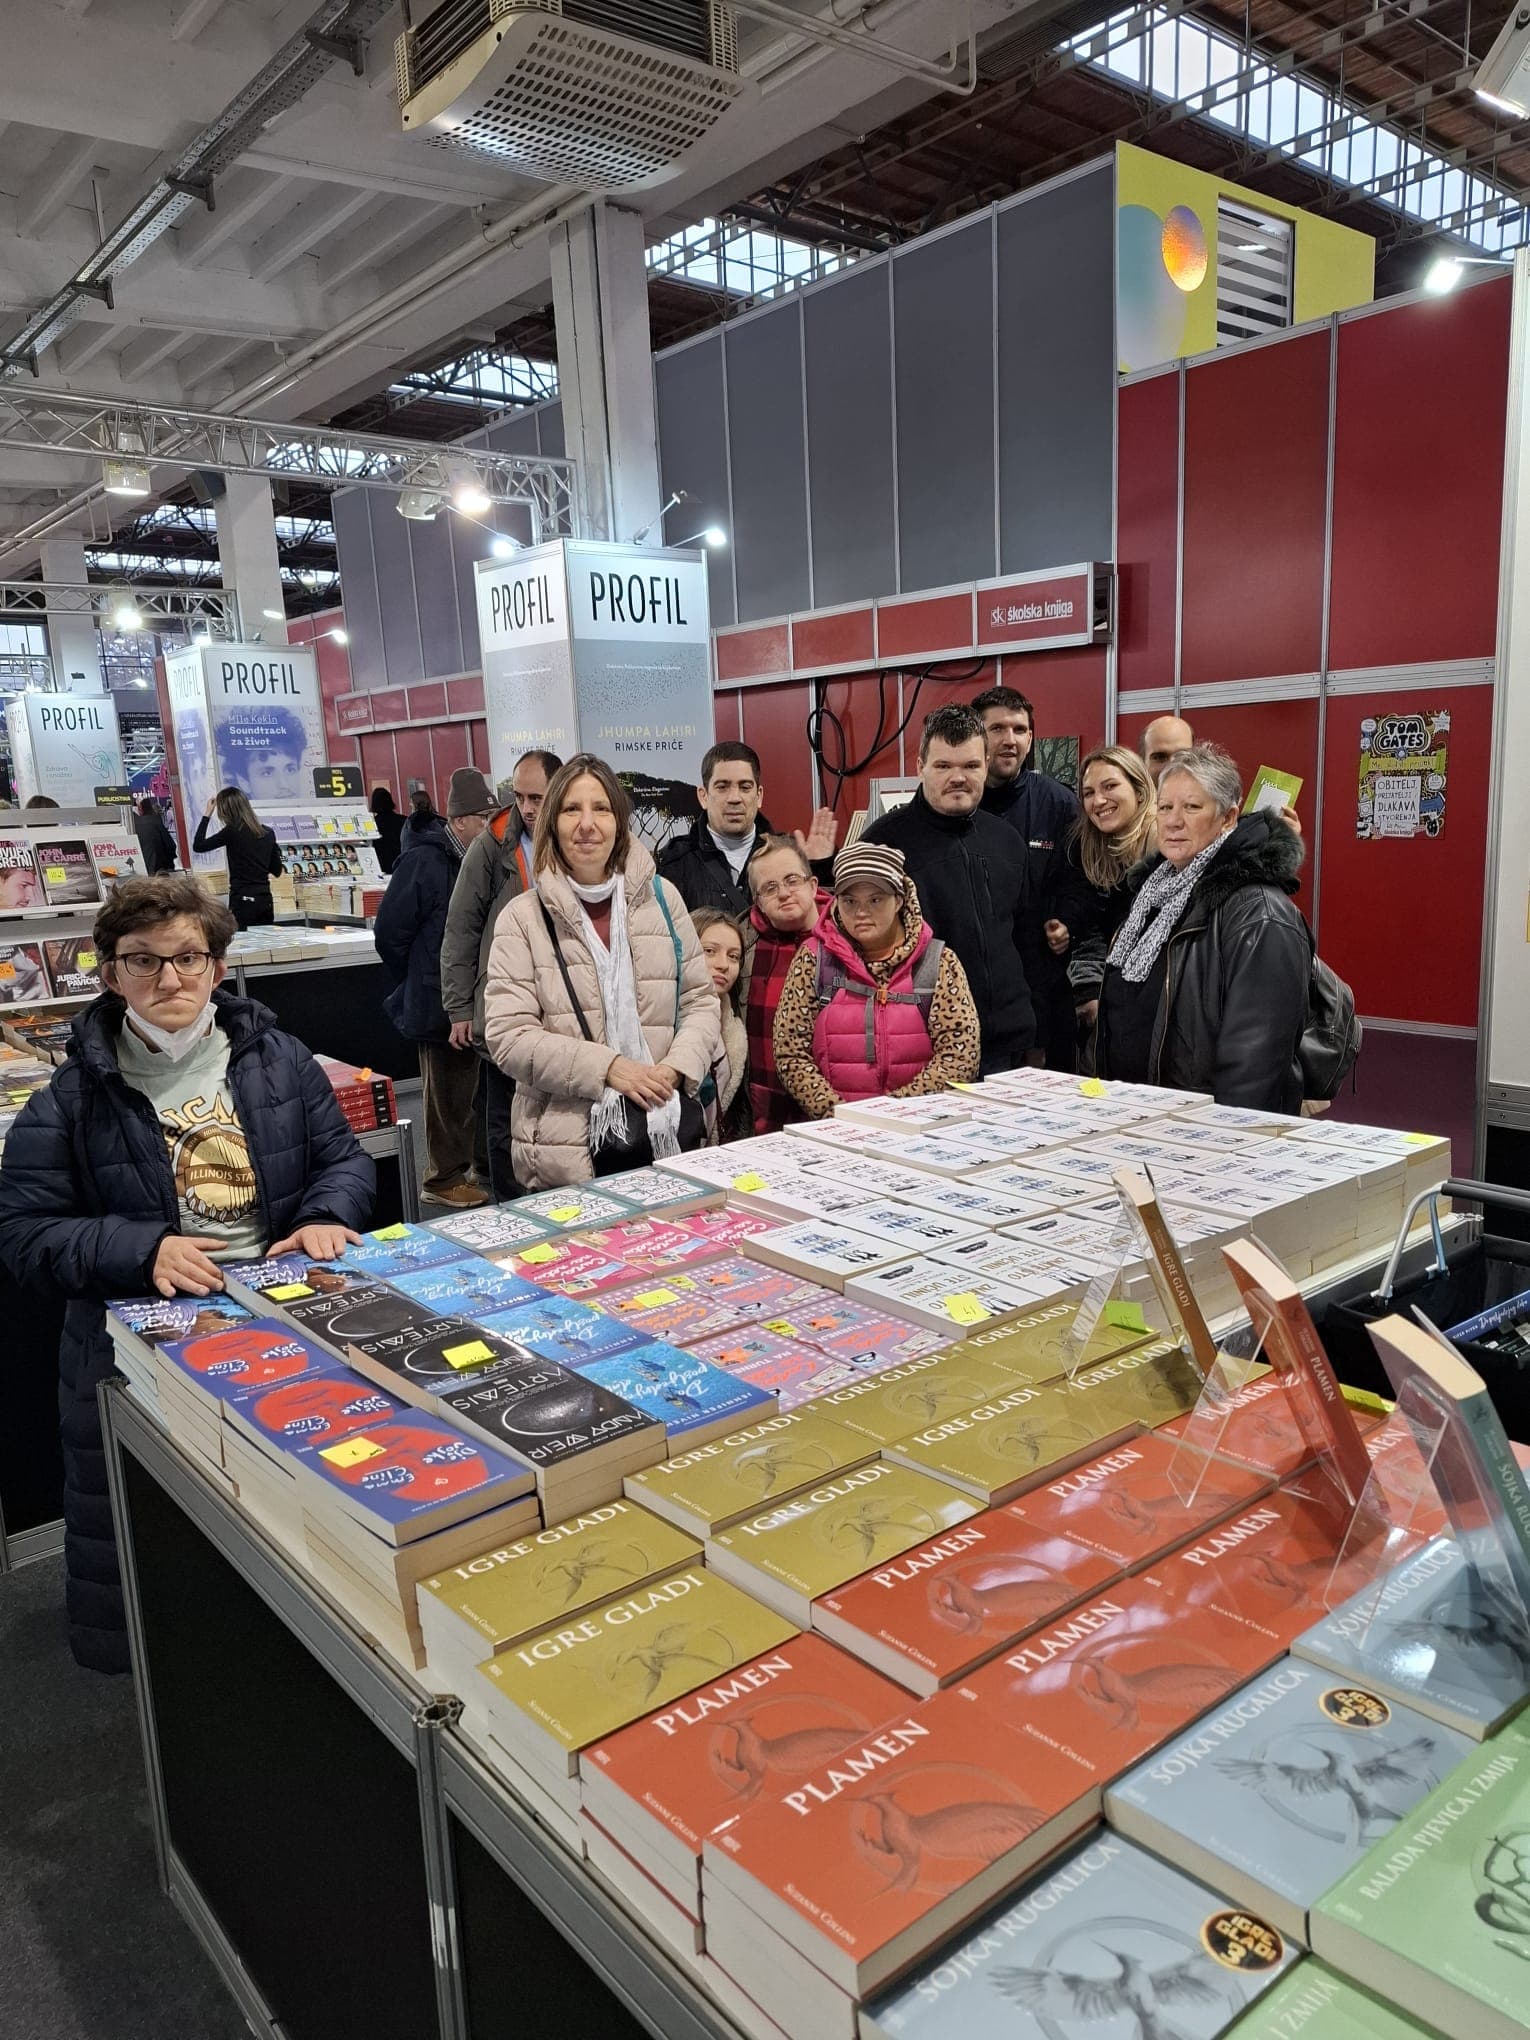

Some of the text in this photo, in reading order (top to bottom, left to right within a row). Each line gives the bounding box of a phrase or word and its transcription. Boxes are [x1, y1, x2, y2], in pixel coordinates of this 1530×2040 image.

[491, 575, 554, 633] PROFIL
[590, 572, 688, 625] PROFIL
[1008, 602, 1042, 621] školska
[1045, 599, 1073, 616] knjiga
[222, 662, 301, 694] PROFIL
[41, 707, 104, 730] PROFIL
[229, 726, 287, 735] Soundtrack
[598, 725, 697, 738] JHUMPA LAHIRI
[1387, 722, 1419, 734] TOM
[245, 737, 270, 745] život
[615, 739, 684, 752] RIMSKE PRIČE
[1380, 734, 1424, 748] GATES
[332, 776, 346, 796] 5
[1378, 801, 1416, 812] DLAKAVA
[39, 848, 63, 856] JOHN
[93, 843, 116, 851] JOHN
[107, 846, 139, 857] CARRÉ
[190, 1168, 233, 1181] ILLINOIS
[948, 1274, 971, 1286] STE
[1163, 1253, 1191, 1307] IGRE GLADI
[816, 1322, 864, 1342] TURNEJI
[968, 1302, 1078, 1350] IGRE GLADI
[208, 1359, 246, 1370] Cline
[208, 1364, 249, 1376] Emma
[824, 1353, 947, 1406] IGRE GLADI
[1069, 1335, 1184, 1391] IGRE GLADI
[1311, 1356, 1336, 1402] PLAMEN
[702, 1393, 752, 1414] JENNIFER
[912, 1386, 1043, 1448] IGRE GLADI
[1195, 1381, 1280, 1420] PLAMEN
[284, 1416, 325, 1429] Cline
[285, 1423, 330, 1435] Emma
[528, 1407, 648, 1461] ANDY WEIR
[657, 1413, 803, 1476] IGRE GLADI
[362, 1466, 407, 1482] Cline
[364, 1473, 415, 1490] Emma
[1047, 1449, 1145, 1499] PLAMEN
[740, 1463, 893, 1538] IGRE GLADI
[454, 1502, 630, 1581] IGRE GLADI
[1182, 1507, 1282, 1567] PLAMEN
[871, 1527, 987, 1589] PLAMEN
[1330, 1544, 1460, 1638] ŠOJKA RUGALICA
[515, 1574, 705, 1668] IGRE GLADI
[1005, 1600, 1127, 1674] PLAMEN
[652, 1656, 793, 1736] PLAMEN
[1150, 1667, 1310, 1785] ŠOJKA RUGALICA
[782, 1717, 930, 1818] PLAMEN
[1358, 1843, 1423, 1901] BALADA
[1416, 1797, 1475, 1859] PJEVICA
[1479, 1753, 1519, 1791] ZMIJA
[914, 1842, 1121, 2003] ŠOJKA RUGALICA
[1215, 1919, 1276, 1961] GLADI
[1232, 1914, 1276, 1945] IGRE
[1221, 1942, 1246, 1965] 3
[1279, 1978, 1340, 2032] ZMIJA
